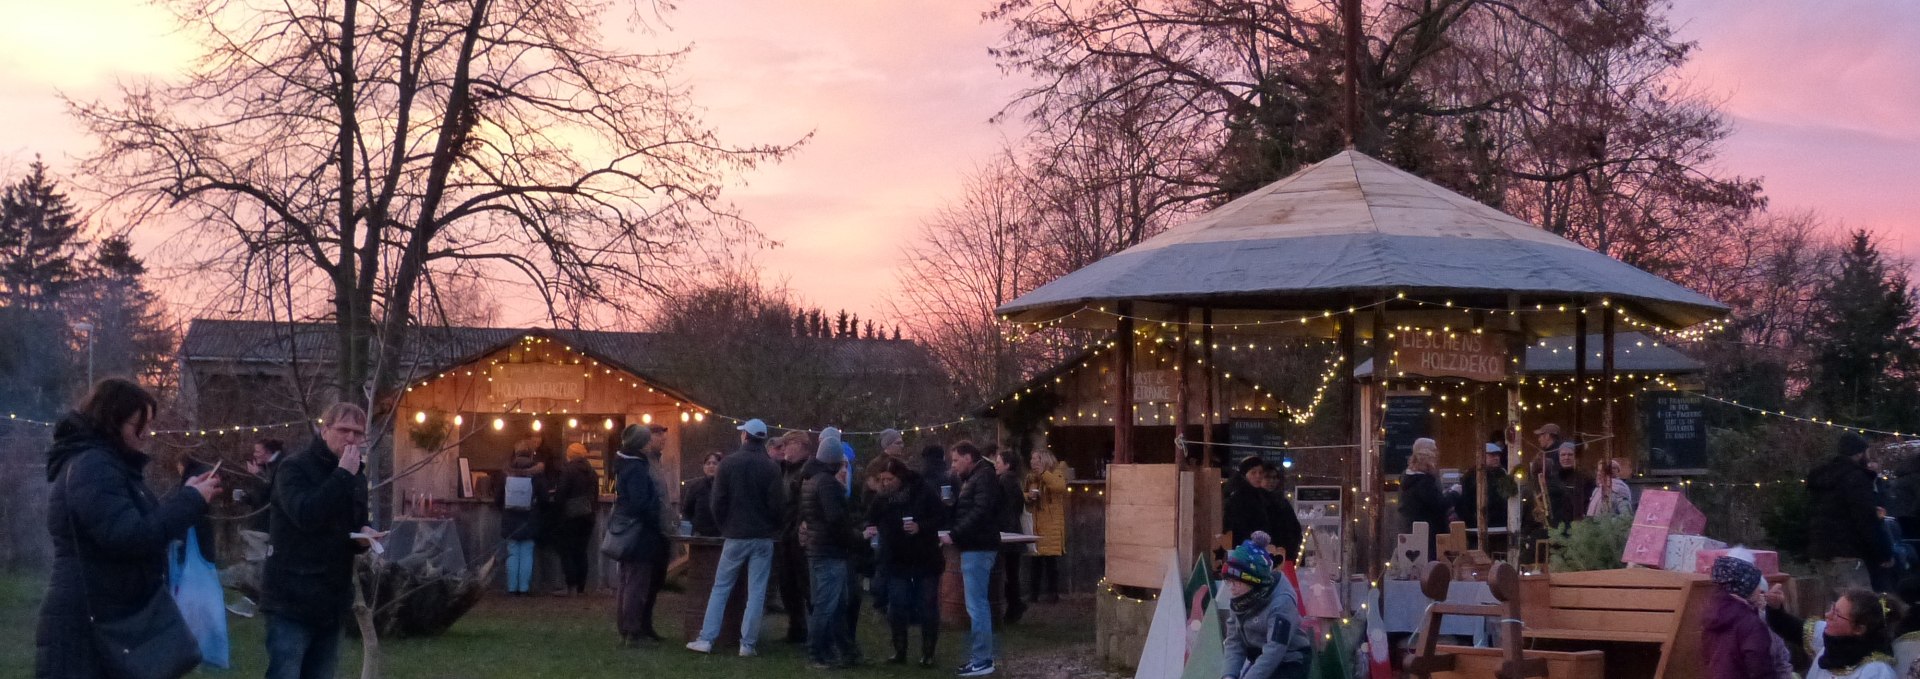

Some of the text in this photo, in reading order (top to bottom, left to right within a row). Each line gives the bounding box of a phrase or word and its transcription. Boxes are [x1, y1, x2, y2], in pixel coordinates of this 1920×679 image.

[1402, 332, 1481, 352] LIESCHENS
[1421, 352, 1499, 373] HOLZDEKO
[1156, 371, 1165, 384] &
[496, 382, 578, 398] HOLZMANUFAKTUR
